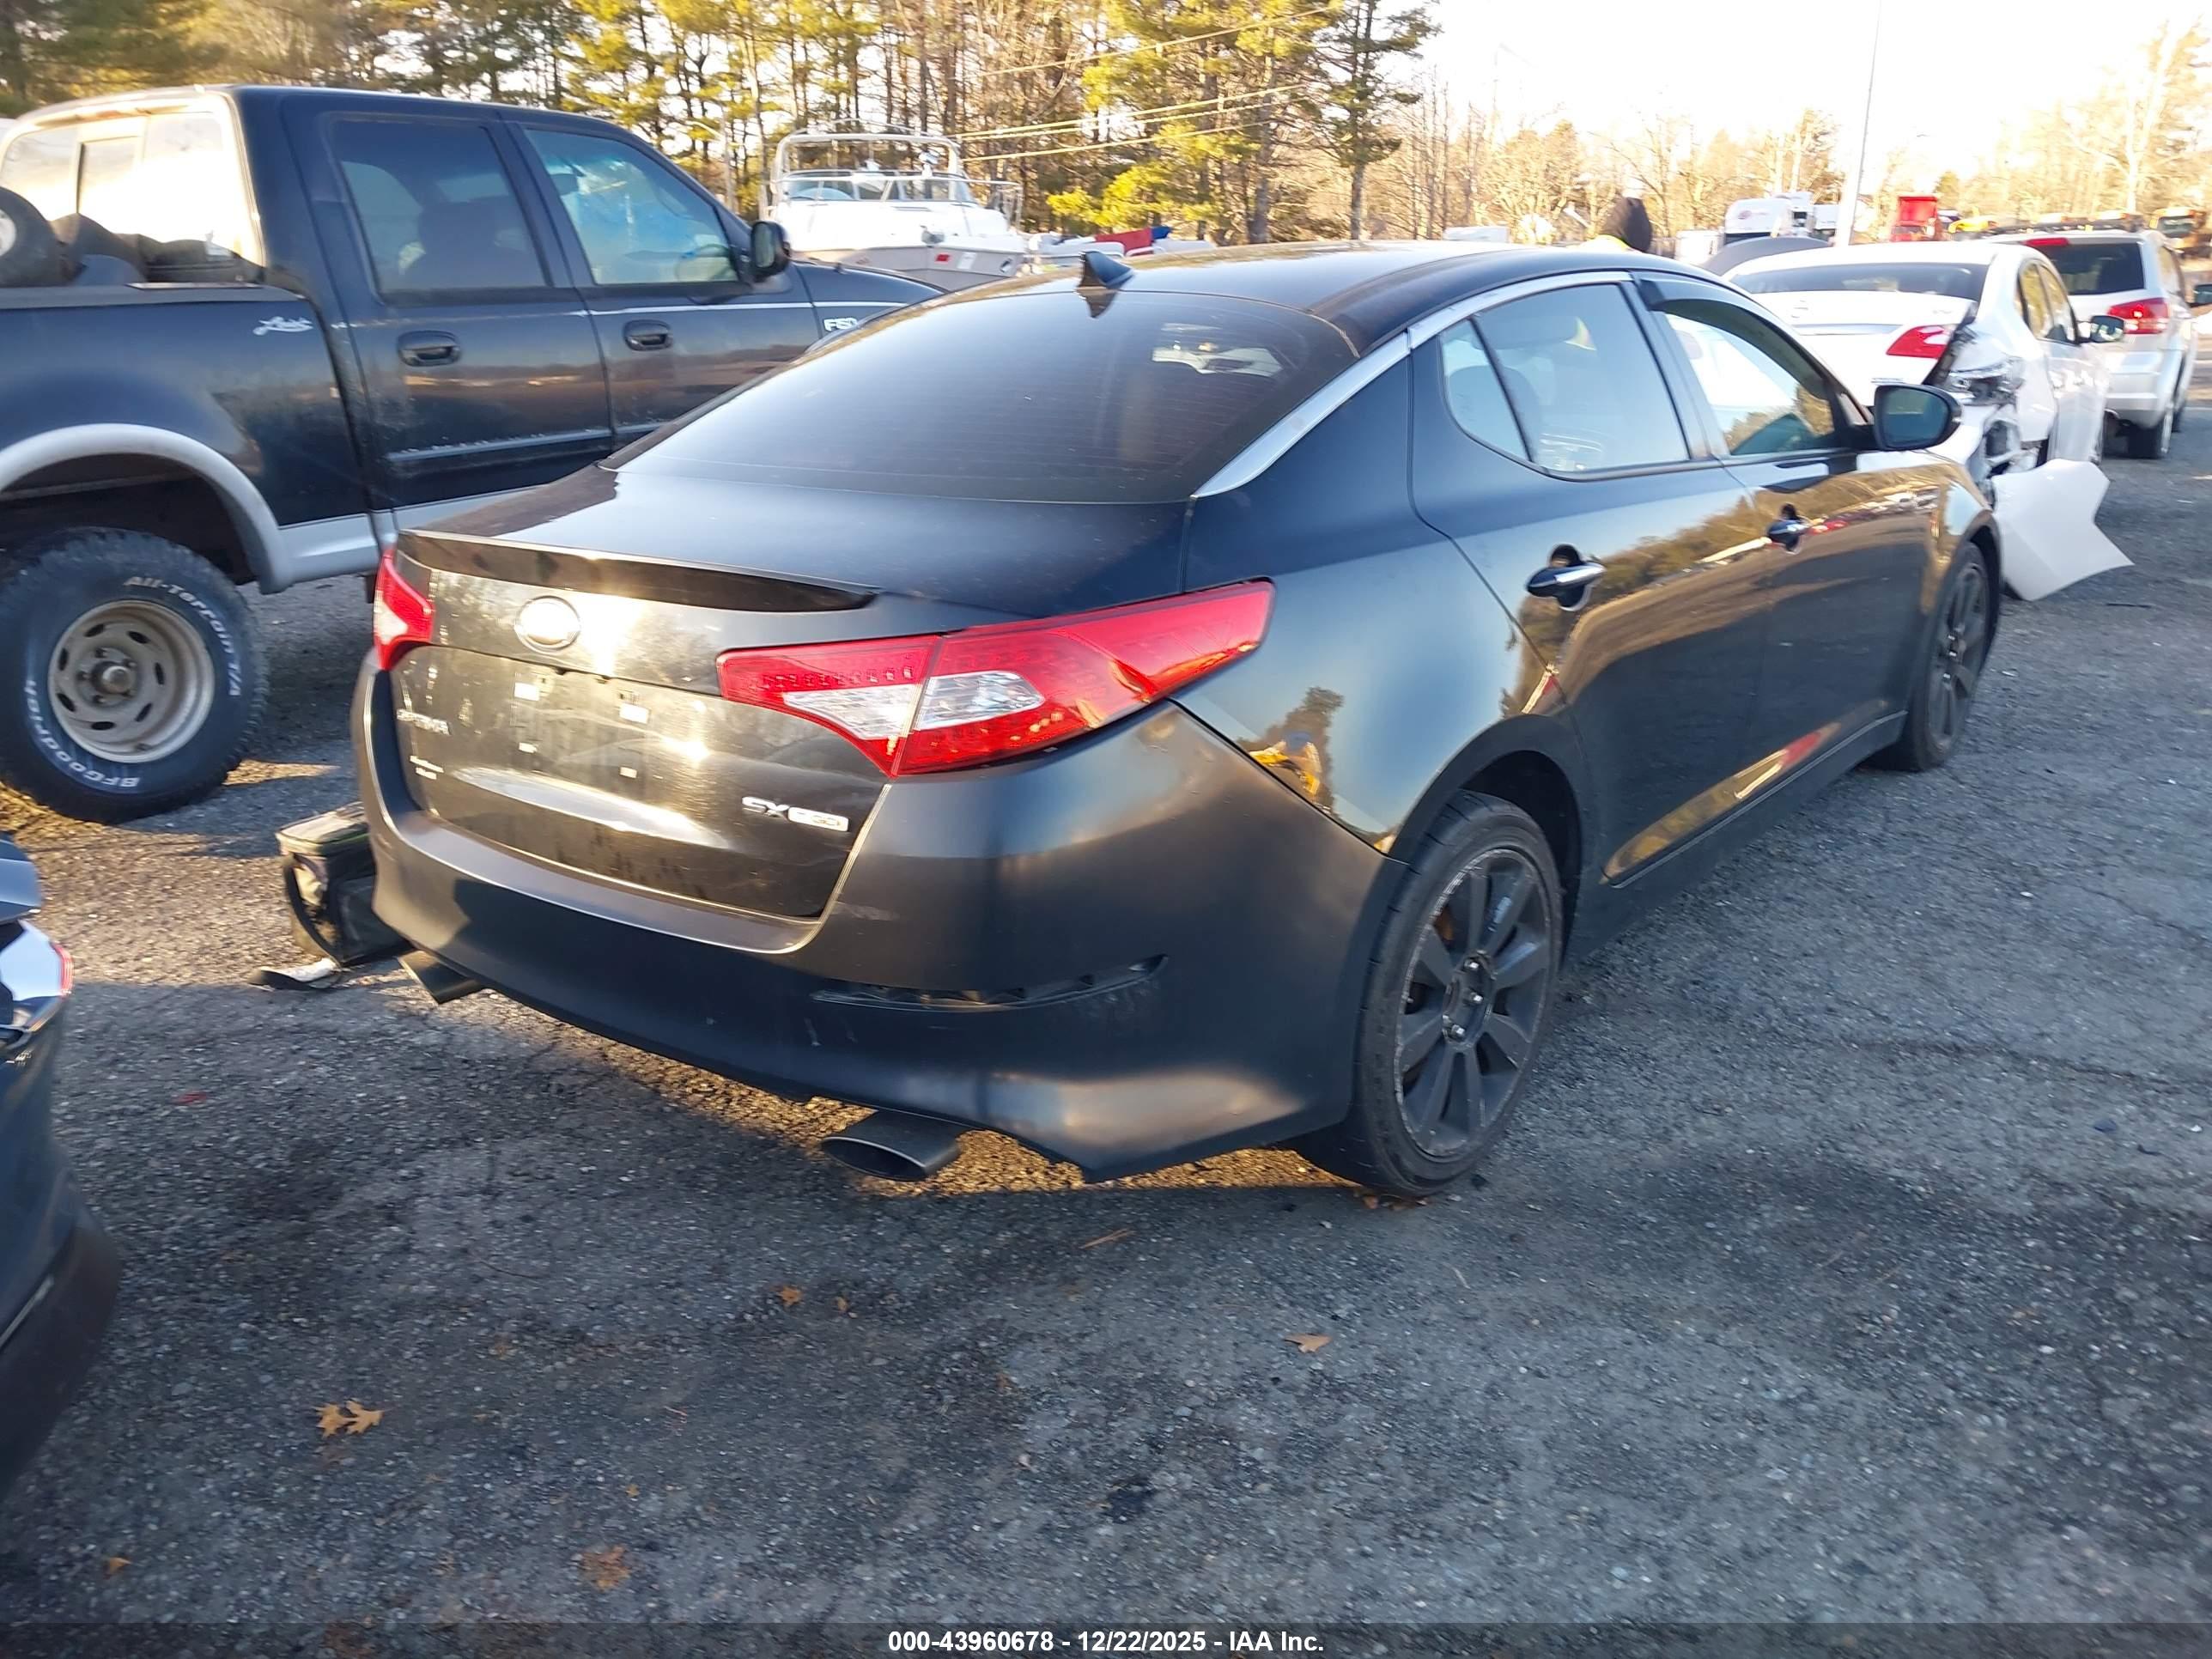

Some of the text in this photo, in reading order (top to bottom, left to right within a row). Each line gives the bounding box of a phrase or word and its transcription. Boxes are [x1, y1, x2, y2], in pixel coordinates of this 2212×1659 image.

[124, 576, 241, 696] All-Terrain T/A
[24, 679, 140, 787] BFGoodrich
